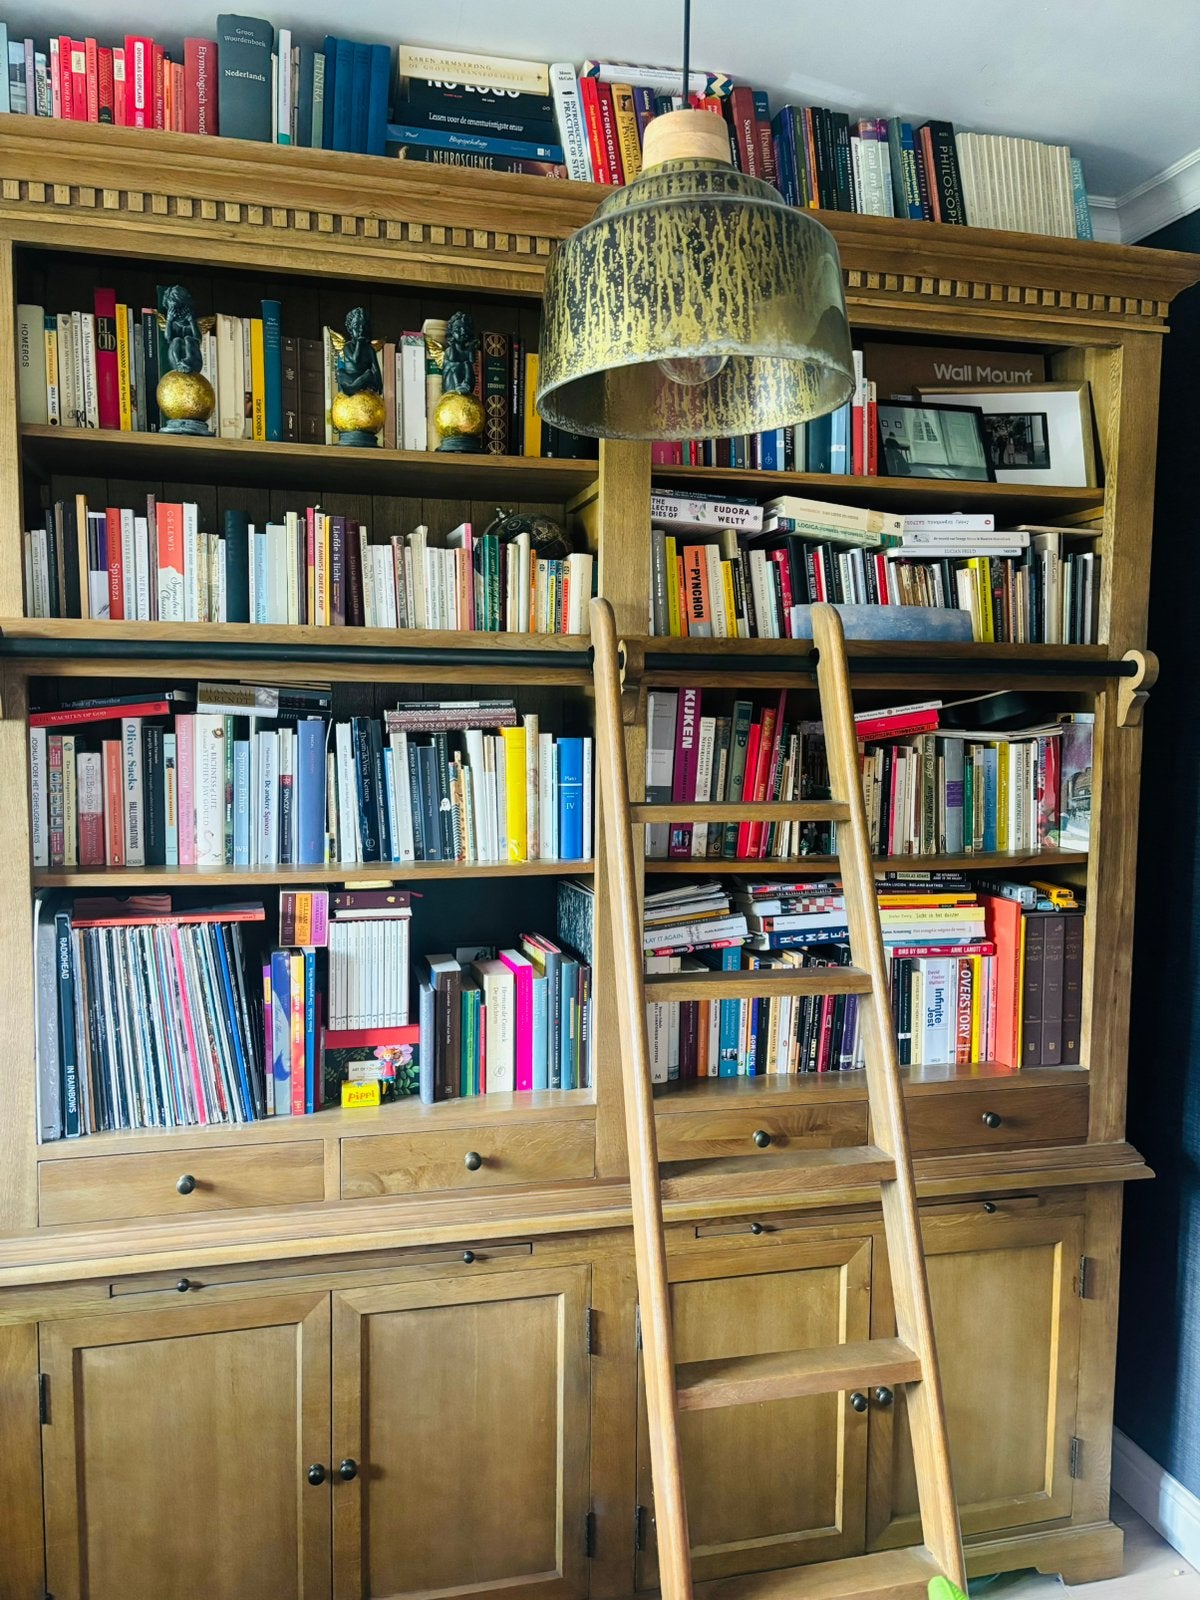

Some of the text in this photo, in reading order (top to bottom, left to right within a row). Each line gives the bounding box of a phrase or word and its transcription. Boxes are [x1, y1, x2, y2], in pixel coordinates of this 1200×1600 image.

[224, 35, 266, 48] Woordenboek
[236, 28, 254, 37] Groot
[196, 46, 208, 104] Etymologisch
[224, 69, 266, 82] Nederlands
[564, 101, 574, 144] PRACTICE
[601, 100, 616, 171] PSYCHOLOGICAL
[433, 150, 494, 170] NEUROSCIENCE
[938, 146, 956, 225] PHILOSOPH
[20, 323, 29, 368] HOMEROS
[934, 362, 1032, 384] Wall Mount
[714, 506, 750, 516] EUDORA
[718, 516, 746, 525] WELTY
[167, 526, 175, 552] LEWIS
[332, 525, 342, 582] Liefde is licht
[109, 562, 120, 601] Spinoza
[690, 568, 704, 619] PYNCHON
[92, 710, 106, 718] GOD
[682, 690, 696, 748] KIJKEN
[126, 724, 138, 791] Oliver Sacks
[236, 752, 248, 814] Spinoza Ethica
[264, 789, 272, 810] andere
[262, 810, 271, 836] Spinoza
[566, 802, 575, 810] IV
[129, 801, 138, 849] HALLUCINATIONS
[646, 936, 656, 944] LAY
[927, 1007, 936, 1028] Jest
[934, 988, 944, 1024] Infinite
[958, 970, 972, 1039] OVERSTORY
[60, 936, 76, 1114] RADIOHEAD IN RAINBOWS
